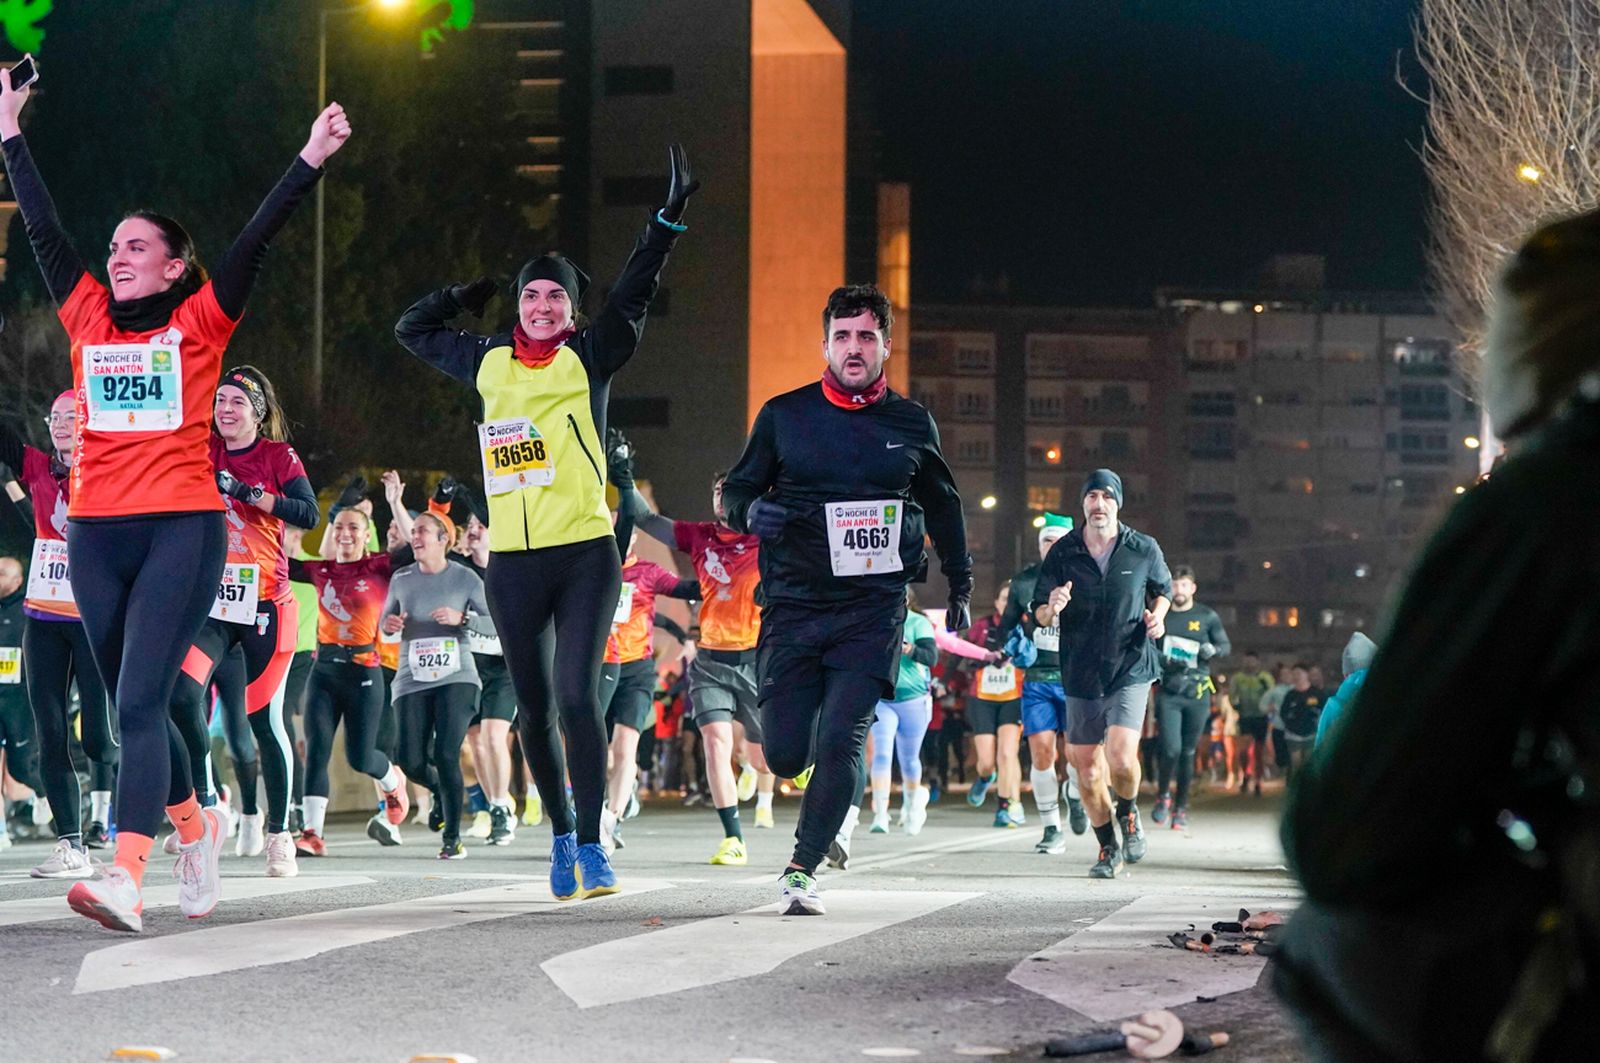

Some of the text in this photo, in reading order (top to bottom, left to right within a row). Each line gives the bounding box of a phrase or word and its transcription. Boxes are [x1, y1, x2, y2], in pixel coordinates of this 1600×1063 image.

[103, 353, 143, 363] NOCHE DE
[93, 365, 111, 375] SAN
[103, 375, 163, 402] 9254
[491, 440, 546, 469] 13658
[845, 509, 868, 517] NOCHE
[869, 508, 878, 517] DE
[836, 519, 852, 528] SAN
[843, 527, 889, 550] 4663
[419, 653, 450, 668] 5242
